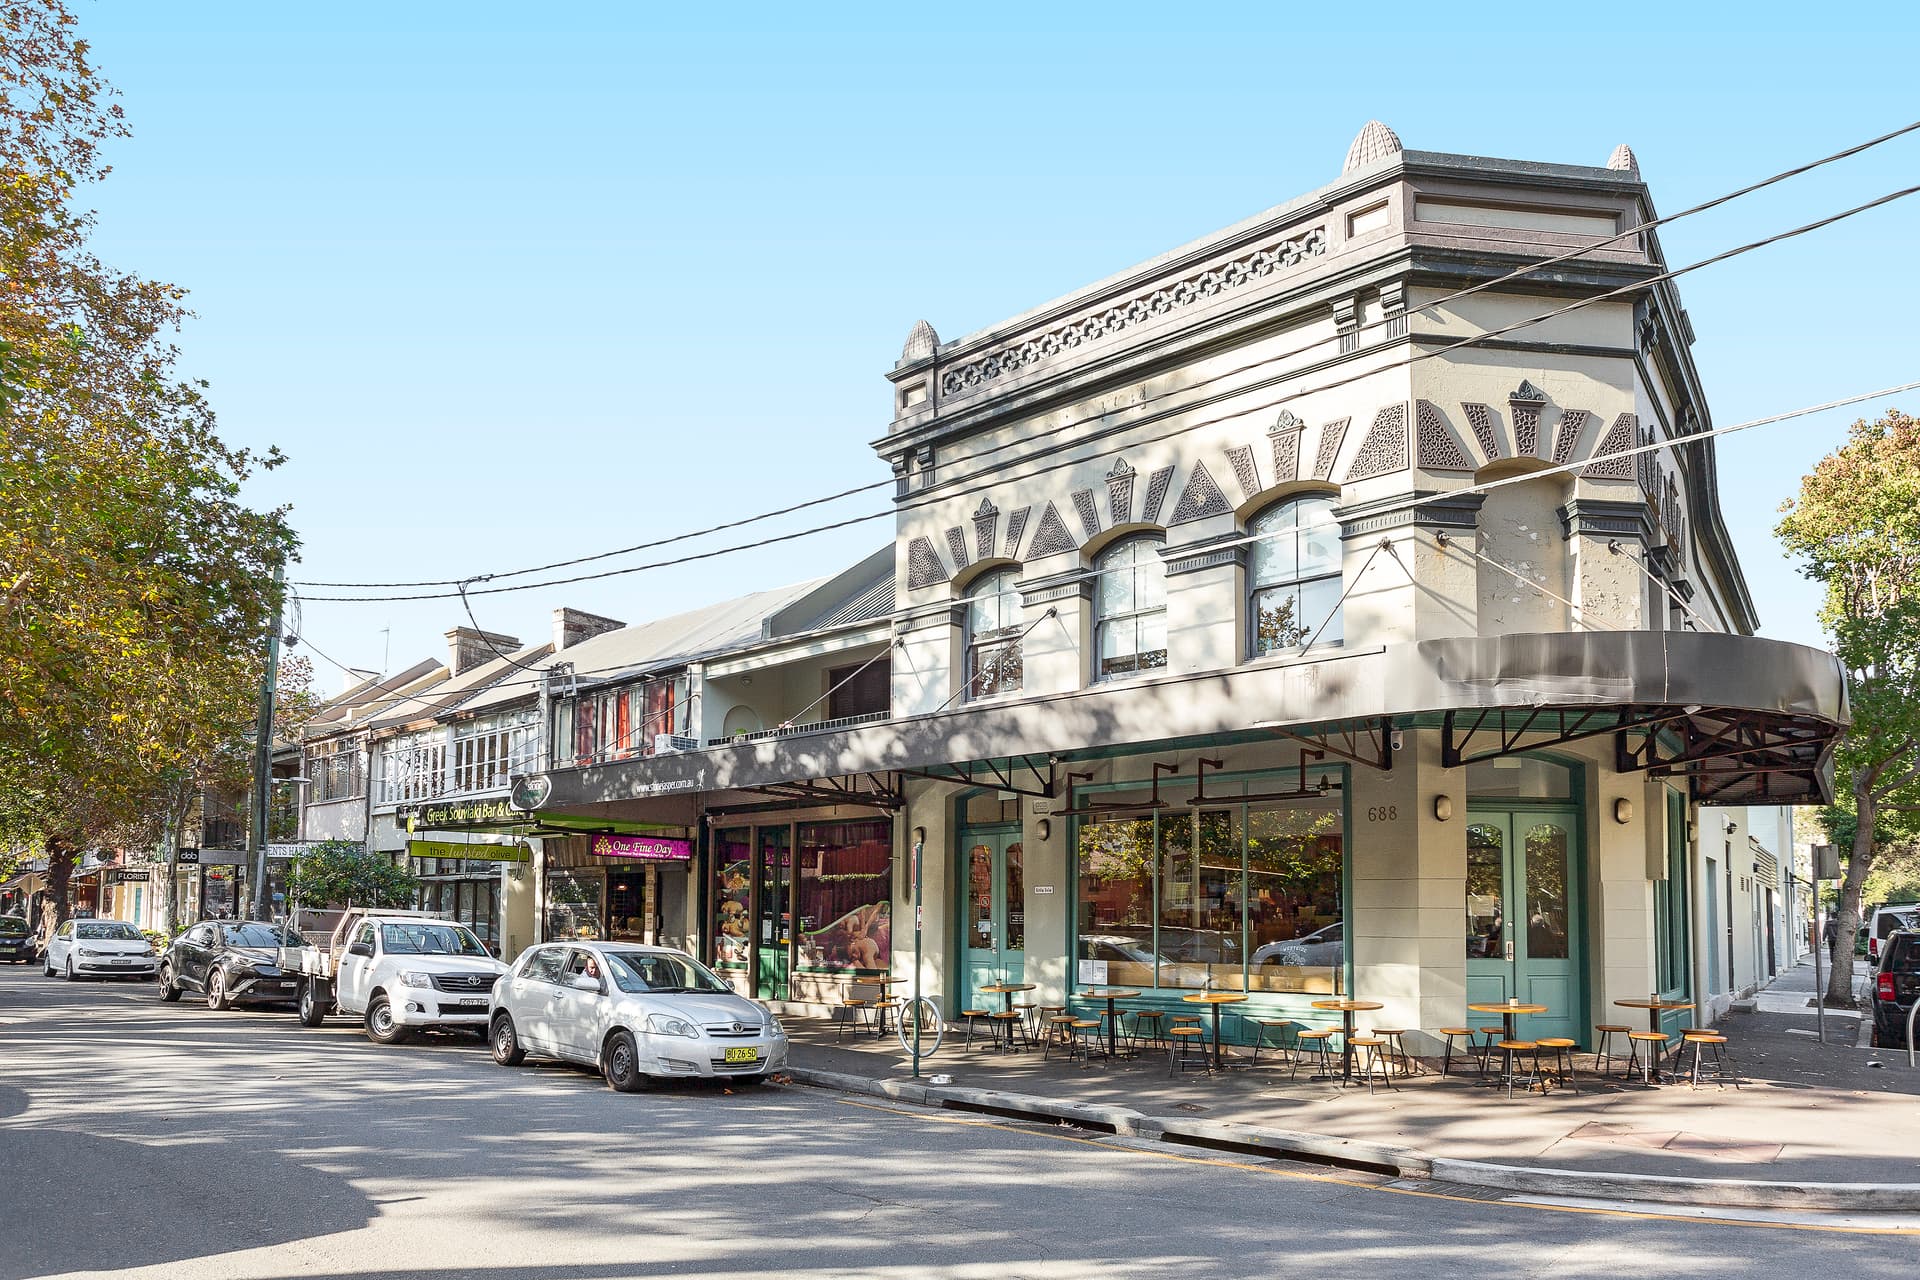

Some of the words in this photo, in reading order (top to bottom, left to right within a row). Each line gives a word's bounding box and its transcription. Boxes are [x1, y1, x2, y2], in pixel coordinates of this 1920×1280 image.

[427, 807, 448, 822] Greek
[450, 803, 480, 819] Souvlaki
[482, 802, 496, 816] Bar
[497, 802, 505, 816] &
[1368, 806, 1397, 822] 688
[430, 846, 446, 856] the
[491, 850, 511, 860] olive
[613, 841, 631, 851] One
[633, 842, 652, 853] Fine
[654, 844, 673, 857] Day
[118, 872, 149, 881] FLORIST
